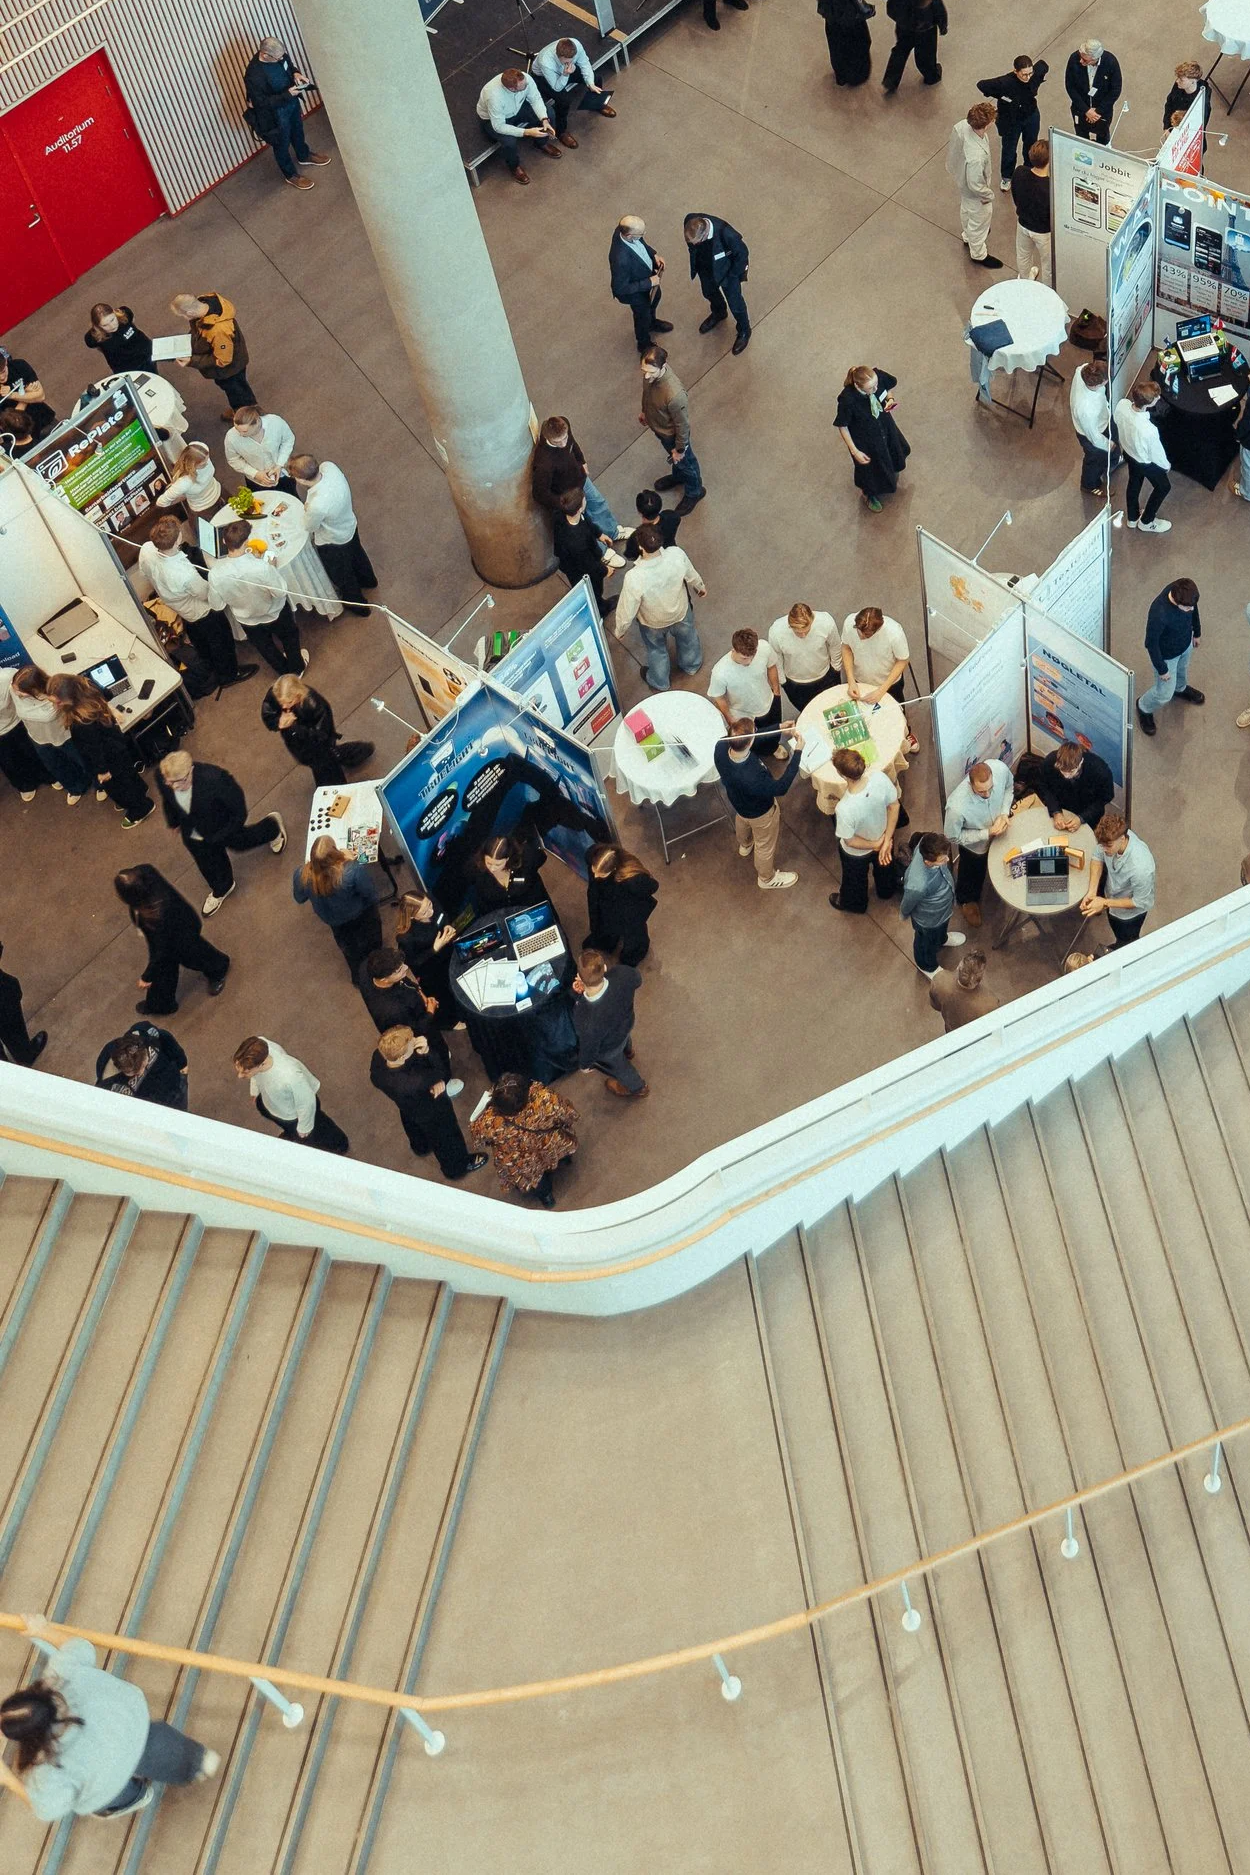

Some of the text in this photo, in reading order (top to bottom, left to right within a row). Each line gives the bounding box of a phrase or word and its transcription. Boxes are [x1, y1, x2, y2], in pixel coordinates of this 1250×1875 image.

[45, 116, 95, 156] Auditorium
[62, 134, 82, 154] 11.57
[1099, 162, 1131, 179] Jobbit
[1162, 264, 1187, 279] 43%
[1192, 274, 1217, 290] 95%
[1223, 285, 1248, 301] 70%
[68, 410, 124, 457] RePlate
[1042, 648, 1106, 698] NØGLETAL
